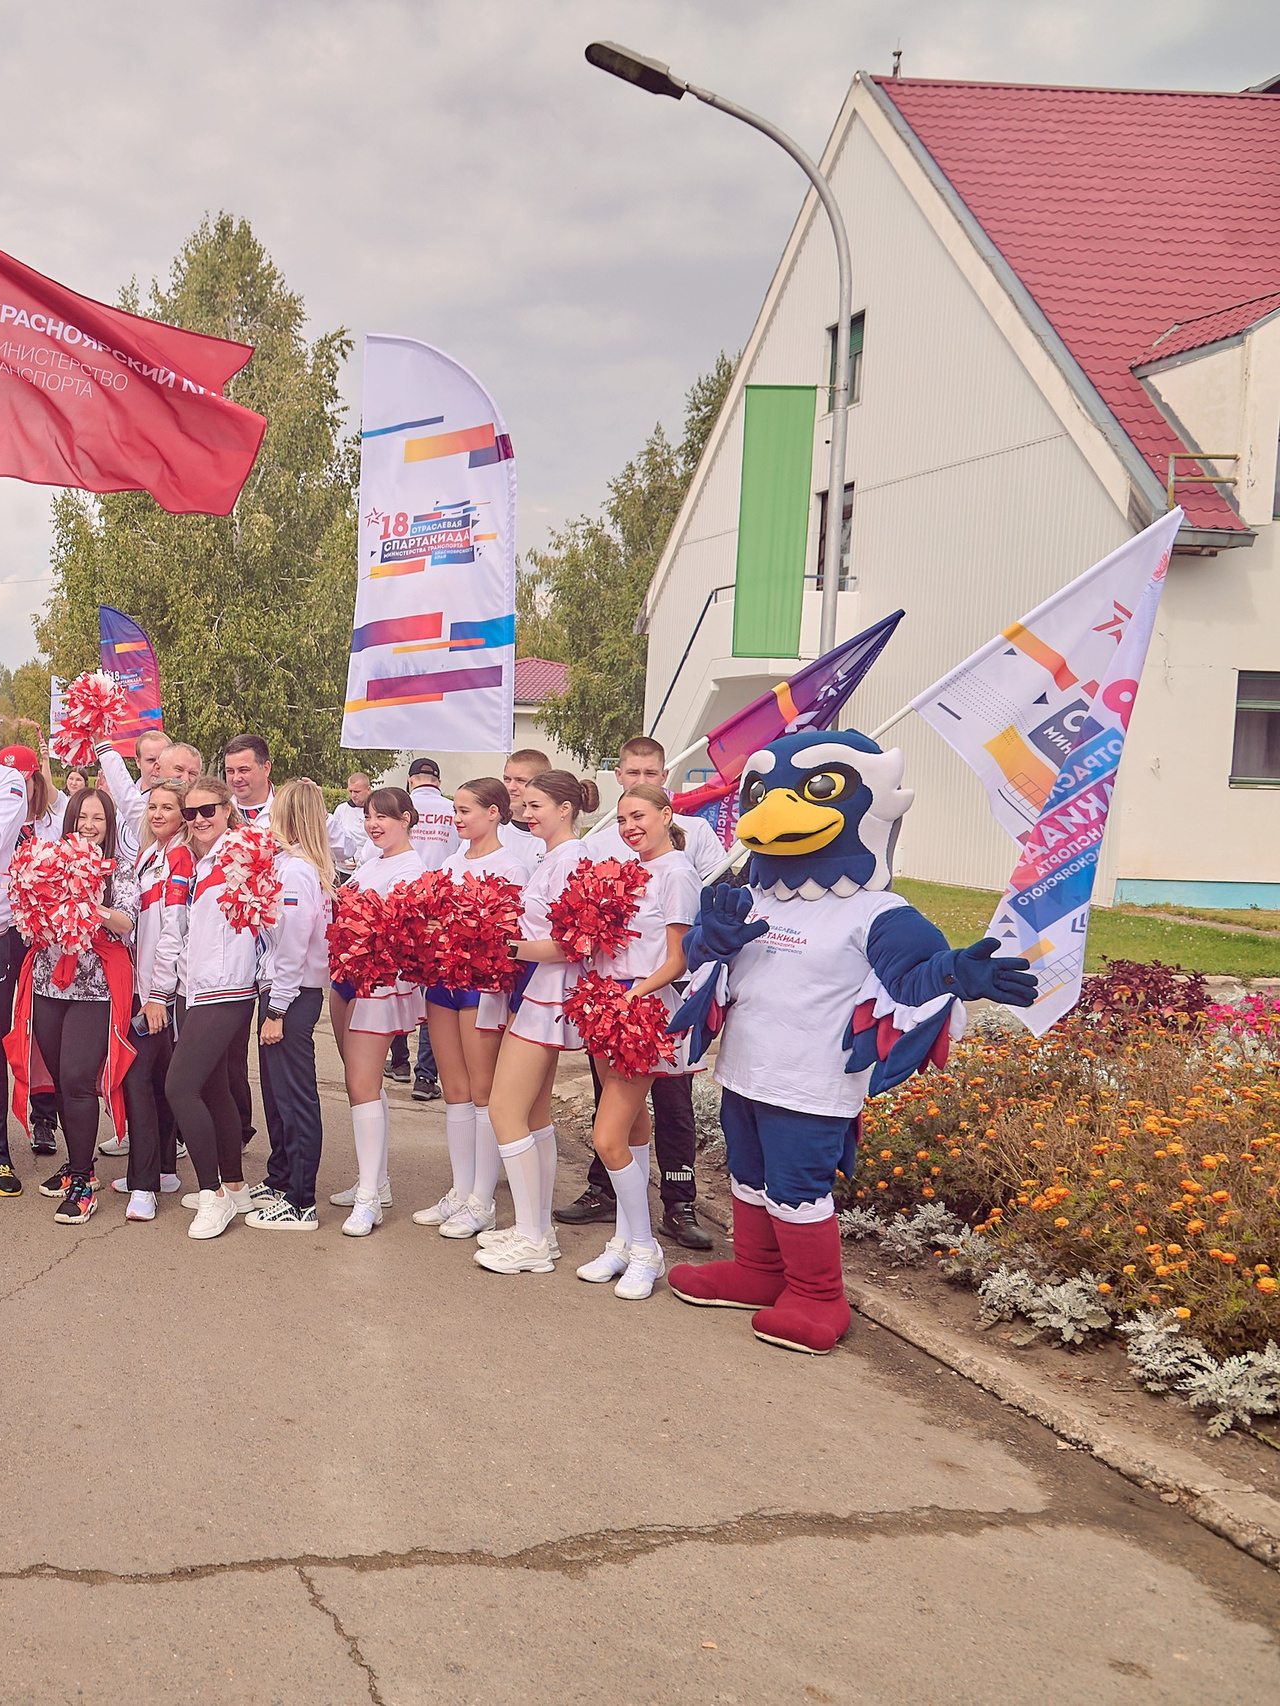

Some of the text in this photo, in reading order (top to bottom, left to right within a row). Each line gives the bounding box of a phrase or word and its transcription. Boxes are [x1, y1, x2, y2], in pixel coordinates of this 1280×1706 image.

[380, 511, 463, 540] 18 ОТРАСЛЕВАЯ
[383, 530, 470, 552] СПАРТАКИАДА
[383, 543, 464, 560] МИНИСТЕРСТВА ТРАНСПОРТА
[665, 1171, 692, 1181] PUMA
